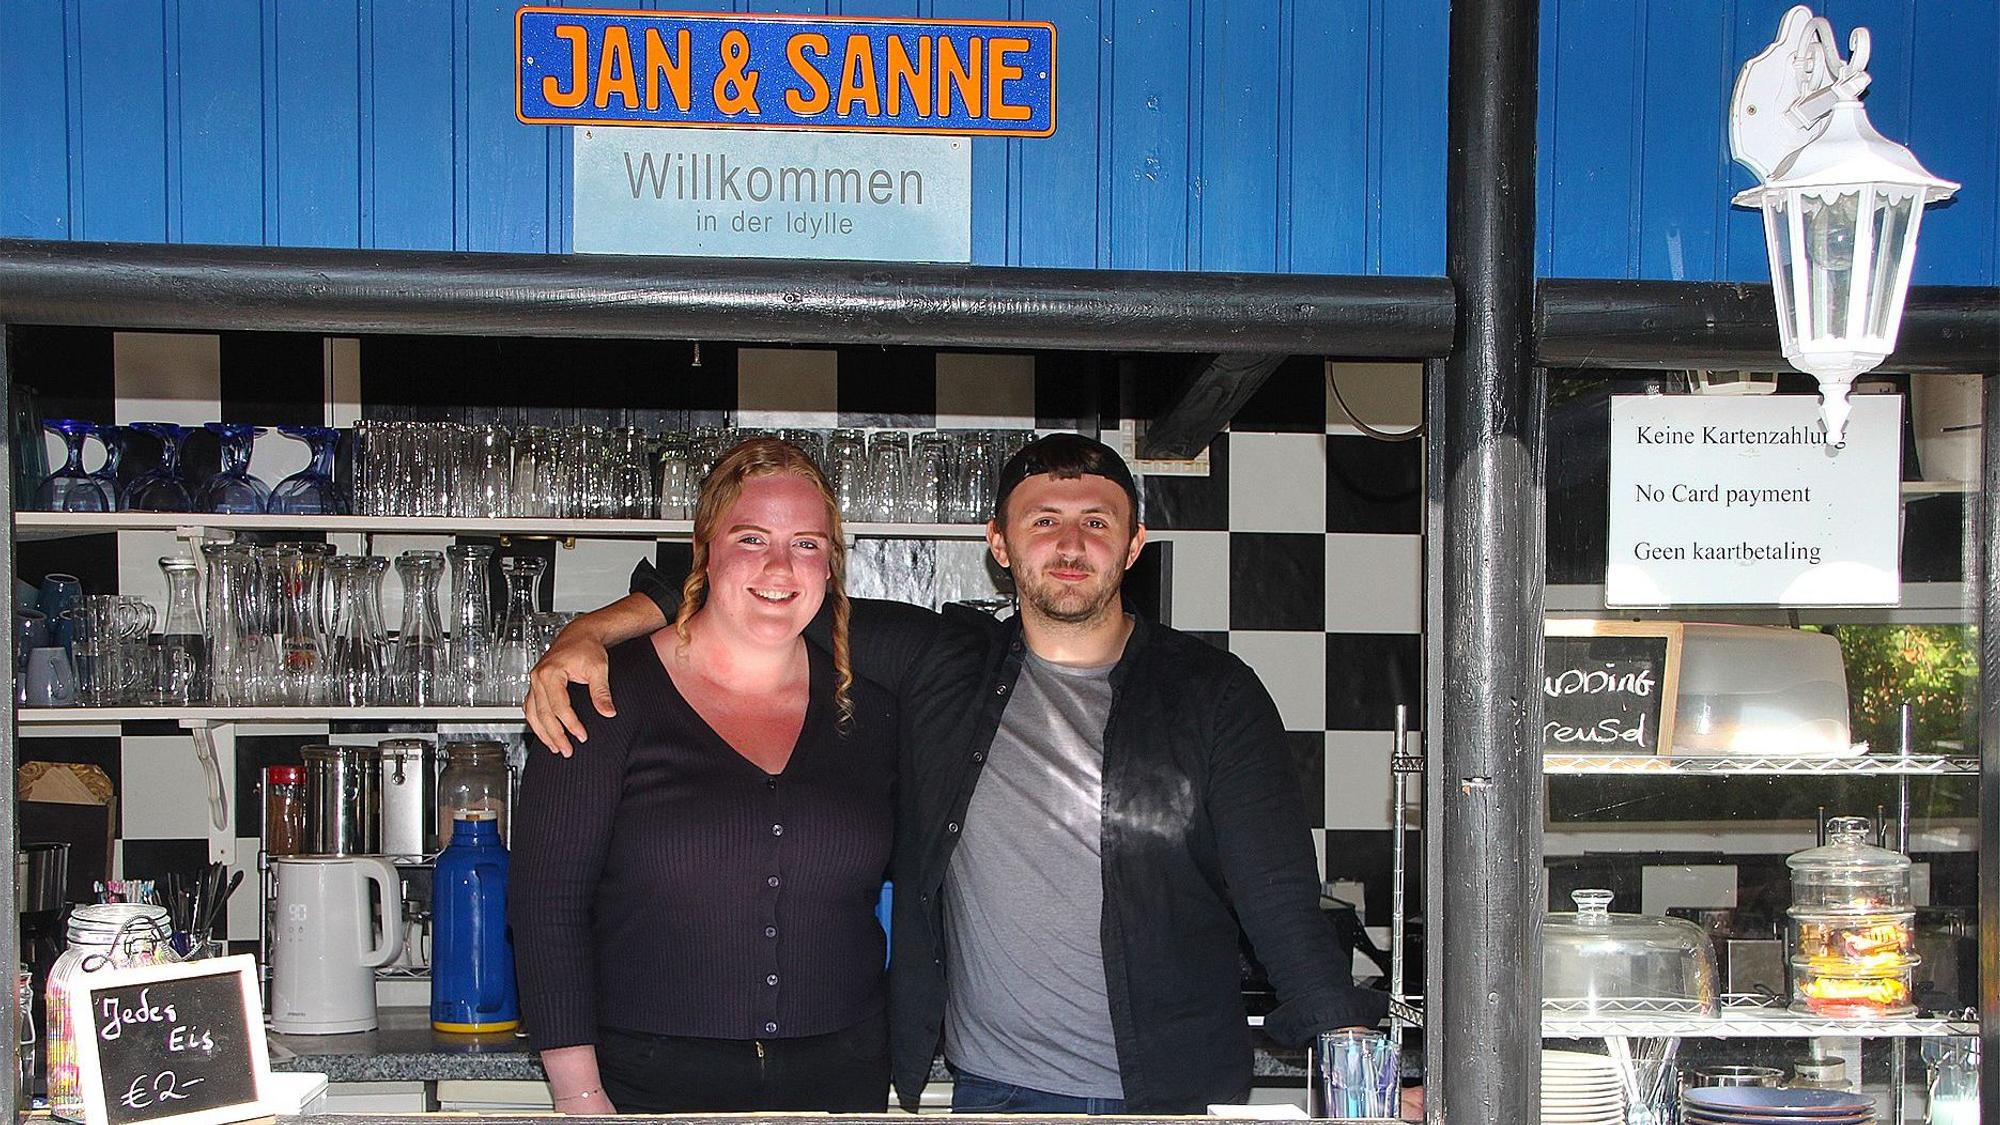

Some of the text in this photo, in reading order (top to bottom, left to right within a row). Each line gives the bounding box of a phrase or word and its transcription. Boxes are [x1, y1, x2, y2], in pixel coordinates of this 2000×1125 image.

[543, 24, 1033, 121] JAN & SANNE
[624, 151, 924, 205] Willkommen
[696, 210, 854, 238] in der Idylle
[1637, 426, 1695, 445] Keine
[1635, 484, 1811, 507] No Card payment
[1634, 541, 1822, 565] Geen kaartbetaling
[101, 987, 177, 1040] Jedes
[168, 1025, 215, 1052] Eis
